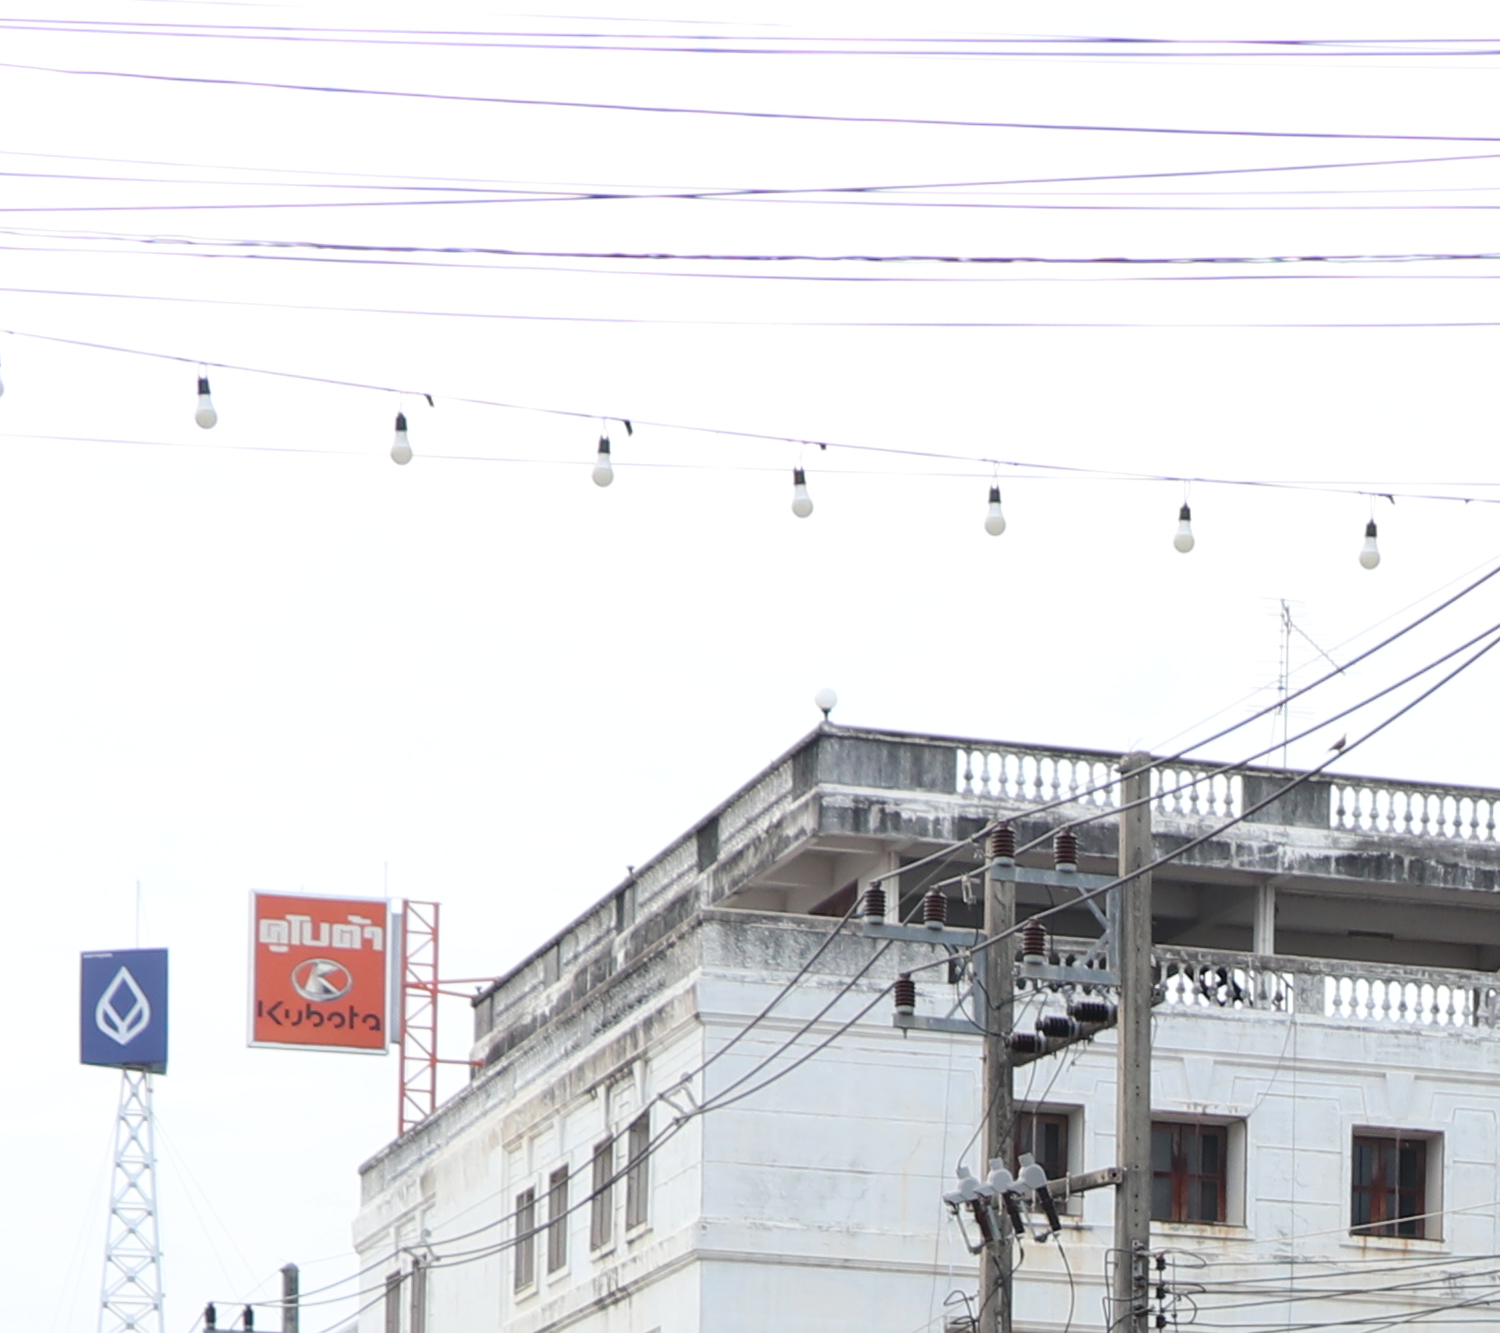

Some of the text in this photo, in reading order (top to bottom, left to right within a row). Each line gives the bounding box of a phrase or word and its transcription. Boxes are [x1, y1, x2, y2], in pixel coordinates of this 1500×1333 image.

[259, 914, 383, 954] คูโบต้า
[257, 1000, 381, 1031] Kubota
